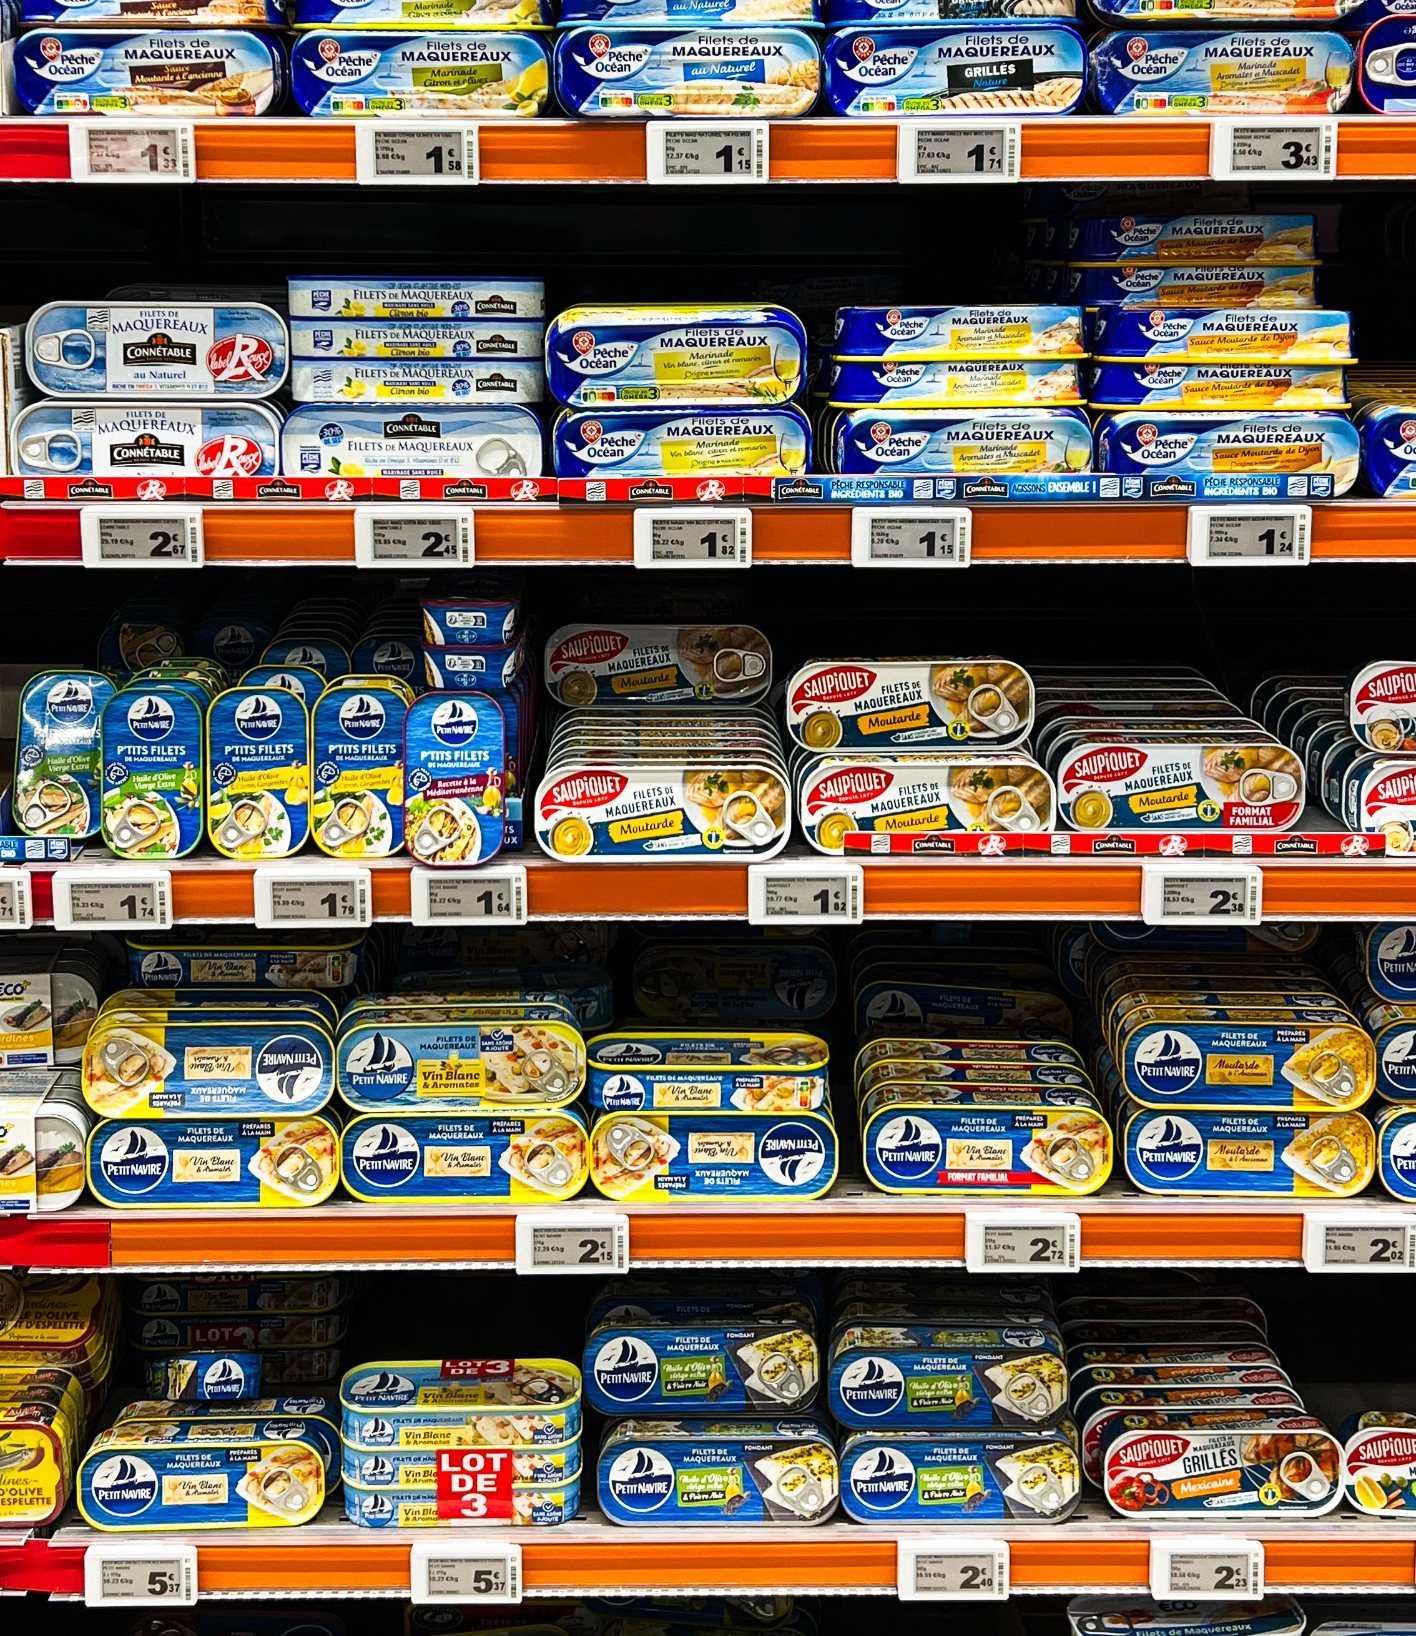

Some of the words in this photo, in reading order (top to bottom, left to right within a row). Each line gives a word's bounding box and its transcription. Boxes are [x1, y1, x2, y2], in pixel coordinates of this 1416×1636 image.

[150, 39, 186, 48] Filets
[191, 39, 210, 48] de
[125, 49, 235, 60] MAQUEREAUX
[402, 51, 511, 62] MAQUEREAUX
[608, 51, 642, 62] Pêche
[672, 46, 783, 57] MAQUEREAUX
[938, 46, 1055, 58] MAQUEREAUX
[1205, 47, 1314, 58] MAQUEREAUX
[61, 53, 95, 66] Pêche
[338, 55, 372, 67] Pêche
[873, 53, 908, 66] Pêche
[1145, 54, 1179, 66] Pêche
[49, 65, 84, 75] Océan
[326, 66, 361, 76] Océan
[595, 62, 631, 72] Océan
[708, 62, 755, 74] Naturel
[859, 66, 896, 76] Océan
[1132, 64, 1167, 75] Océan
[1237, 61, 1277, 70] Marinade
[430, 68, 477, 76] Marinade
[1216, 71, 1252, 80] Aromates
[1263, 68, 1300, 78] Muscadet
[973, 78, 1007, 87] Nature
[141, 145, 157, 171] 1
[163, 159, 177, 168] 33
[426, 147, 443, 173] 1
[448, 161, 461, 170] 58
[716, 145, 732, 172] 1
[738, 160, 750, 169] 15
[967, 145, 984, 171] 1
[989, 159, 1001, 168] 71
[1281, 142, 1304, 169] 3
[1304, 156, 1317, 166] 43
[140, 310, 167, 318] FILETS
[170, 310, 179, 318] DE
[1226, 315, 1256, 323] Filets
[1260, 314, 1277, 322] de
[112, 318, 208, 335] MAQUEREAUX
[952, 317, 1028, 325] MAQUEREAUX
[1203, 322, 1298, 331] MAQUEREAUX
[660, 336, 768, 347] MAQUEREAUX
[127, 346, 192, 358] CONNÉTABLE
[594, 348, 628, 360] Pêche
[690, 350, 734, 359] Marinade
[580, 358, 617, 368] Océan
[134, 372, 146, 380] au
[149, 370, 186, 380] Naturel
[98, 419, 196, 435] MAQUEREAUX
[387, 423, 436, 433] CONNÉTABLE
[668, 425, 773, 436] MAQUEREAUX
[601, 436, 635, 448] Pêche
[1217, 433, 1325, 443] MAQUEREAUX
[348, 440, 383, 451] FILETS
[398, 440, 473, 451] MAQUEREAUX
[114, 447, 180, 459] CONNÉTABLE
[1142, 449, 1176, 458] Océan
[832, 479, 853, 489] PÊCHE
[856, 481, 904, 489] RESPONSABLE
[1012, 484, 1046, 493] AGISSONS
[1048, 483, 1089, 493] ENSEMBLE
[832, 489, 884, 498] INGRÉDIENTS
[888, 489, 903, 498] BIO
[149, 531, 171, 556] 2
[172, 545, 185, 554] 67
[421, 532, 443, 556] 2
[444, 545, 456, 554] 45
[700, 532, 716, 557] 1
[722, 545, 734, 555] 82
[1259, 529, 1274, 554] 1
[1280, 543, 1292, 552] 24
[608, 653, 671, 672] MAQUEREAUX
[882, 682, 909, 694] FILETS
[854, 690, 923, 712] MAQUEREAUX
[868, 711, 921, 729] Moutarde
[117, 745, 148, 755] P'TITS
[151, 745, 186, 755] FILETS
[421, 750, 452, 761] P'TITS
[455, 750, 489, 760] FILETS
[133, 774, 150, 782] Huile
[152, 773, 176, 781] d'Olive
[1125, 772, 1193, 791] MAQUEREAUX
[438, 780, 461, 788] Recette
[1139, 791, 1189, 807] Moutarde
[605, 795, 675, 817] MAQUEREAUX
[1232, 807, 1271, 816] FORMAT
[620, 818, 674, 835] Moutarde
[1229, 816, 1274, 826] FAMILIAL
[120, 895, 136, 919] 1
[141, 908, 154, 917] 74
[477, 891, 492, 914] 1
[498, 903, 510, 912] 64
[1209, 890, 1230, 914] 2
[1232, 903, 1243, 912] 38
[1214, 1060, 1259, 1070] Moutarde
[422, 1071, 442, 1081] Vin
[445, 1071, 480, 1081] Blanc
[1141, 1066, 1163, 1077] PETIT
[1165, 1065, 1195, 1077] NAVIRE
[353, 1074, 374, 1085] PETIT
[376, 1074, 407, 1085] NAVIRE
[882, 1151, 904, 1162] PETIT
[905, 1151, 935, 1162] NAVIRE
[108, 1164, 130, 1175] PETIT
[132, 1164, 161, 1175] NAVIRE
[948, 1173, 974, 1182] FORMAT
[977, 1173, 1008, 1182] FAMILIAL
[579, 1240, 600, 1263] 2
[601, 1252, 612, 1260] 15
[601, 1372, 622, 1383] PETIT
[623, 1372, 652, 1383] NAVIRE
[441, 1453, 507, 1471] LOT
[1183, 1449, 1237, 1474] GRILLÉS
[452, 1474, 497, 1492] DE
[1180, 1477, 1235, 1493] Mexicaine
[98, 1489, 119, 1500] PETIT
[122, 1489, 151, 1500] NAVIRE
[461, 1494, 487, 1517] 3
[148, 1572, 167, 1595] 5
[169, 1584, 180, 1593] 37
[1183, 1623, 1251, 1633] Maquereaux
